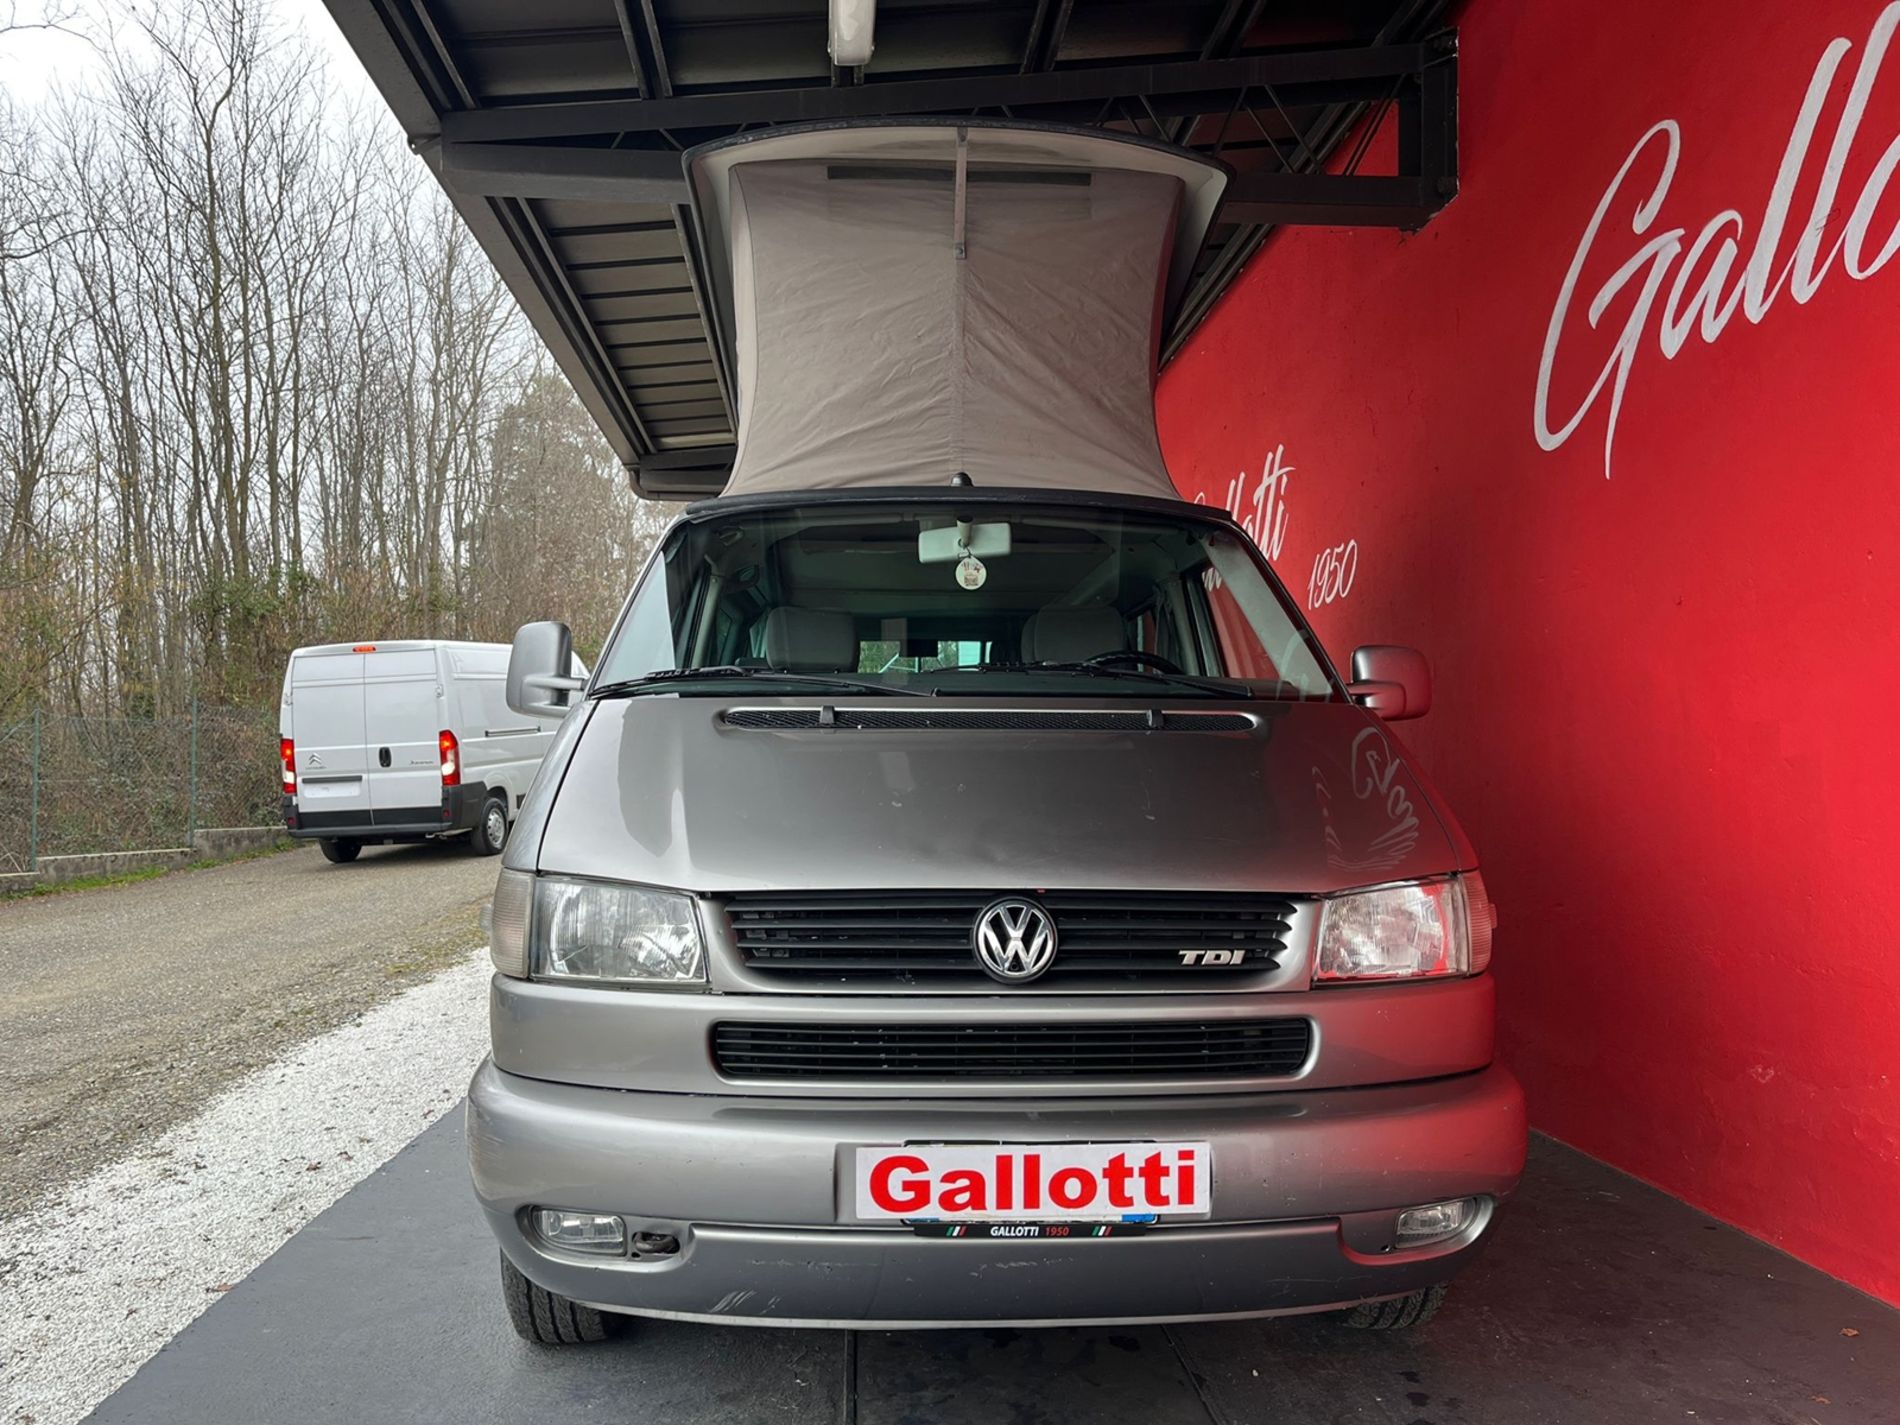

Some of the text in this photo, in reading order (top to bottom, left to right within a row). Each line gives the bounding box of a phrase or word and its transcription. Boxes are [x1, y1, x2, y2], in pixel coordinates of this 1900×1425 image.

[1307, 539, 1358, 610] 1950
[1179, 950, 1246, 965] TDI
[869, 1149, 1195, 1213] Gallotti
[990, 1226, 1070, 1237] GALLOTTI 1950
